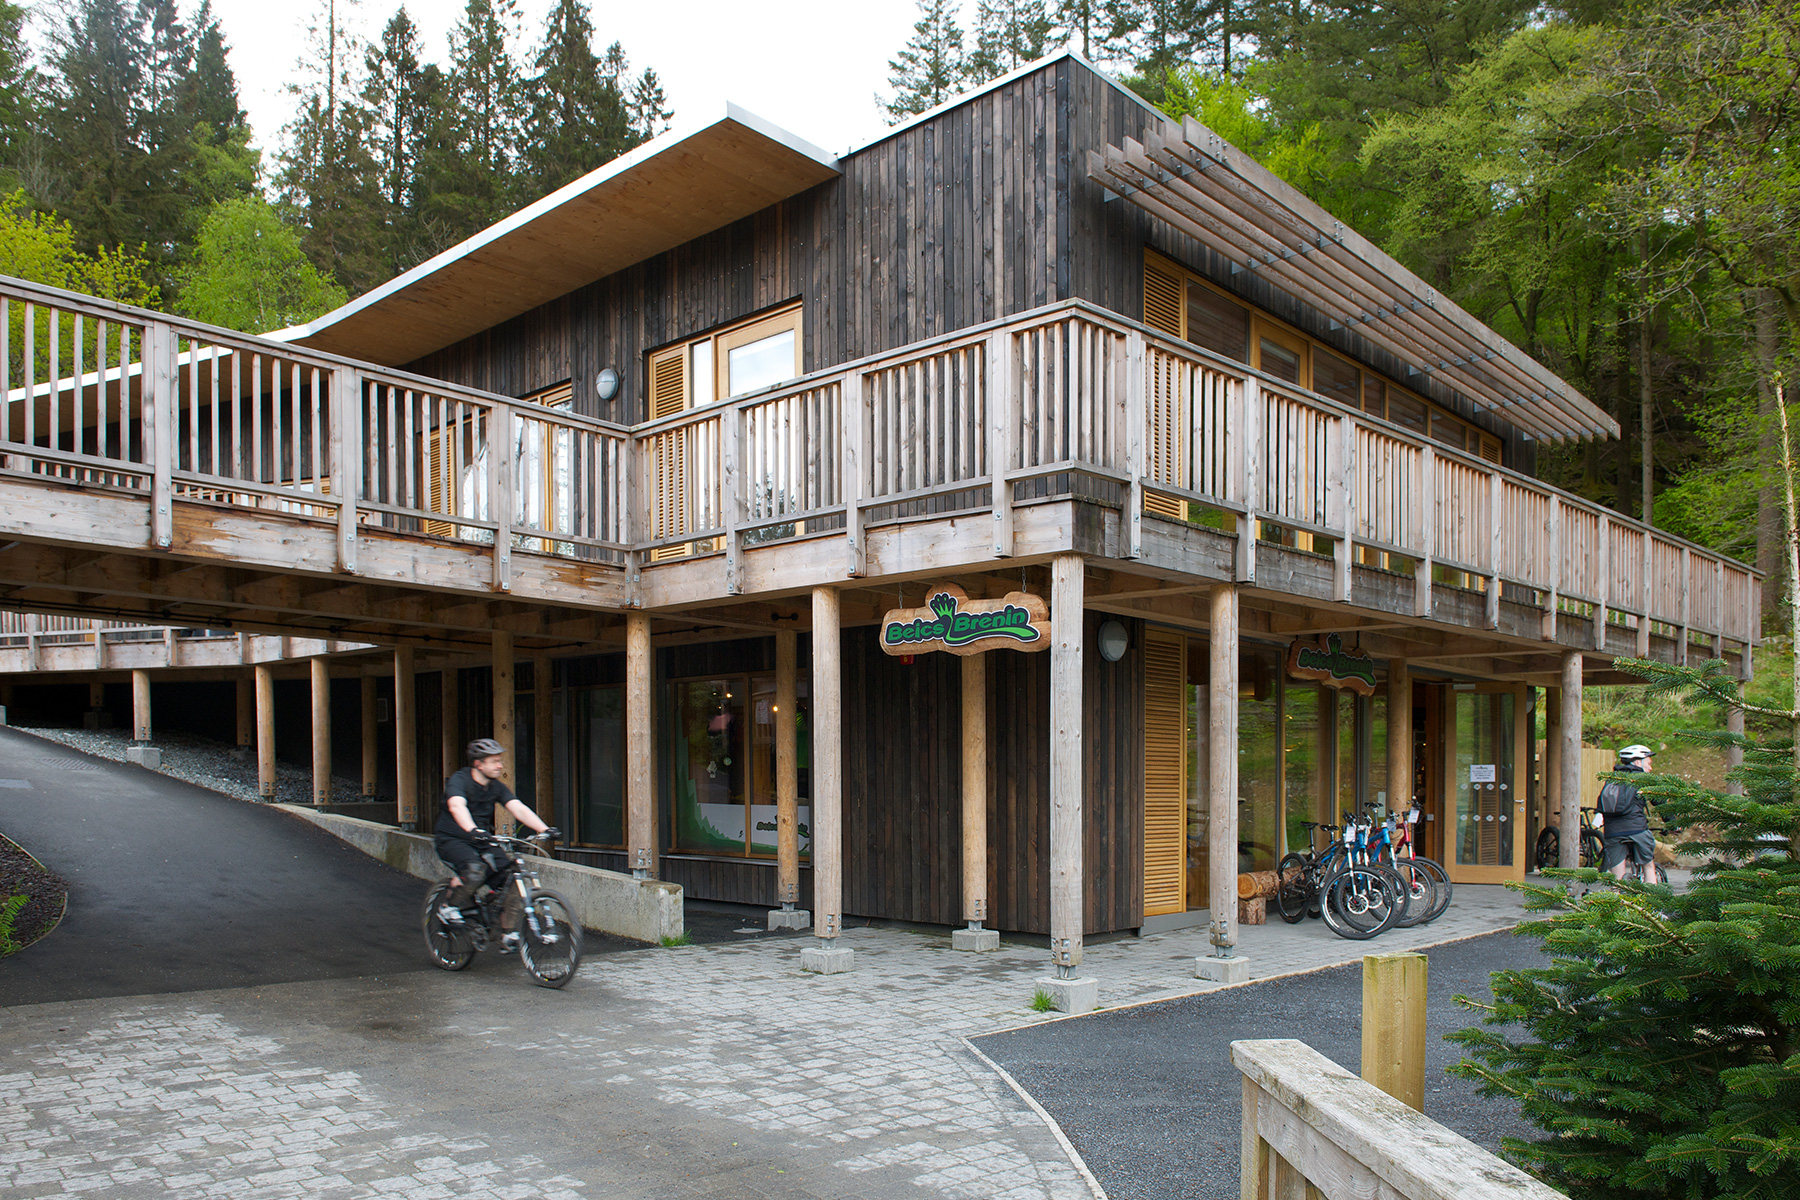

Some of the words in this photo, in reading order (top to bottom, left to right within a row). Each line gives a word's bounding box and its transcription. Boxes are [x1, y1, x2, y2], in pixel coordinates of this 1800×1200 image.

[887, 623, 944, 641] Beics
[954, 609, 1026, 632] Brenin
[1299, 650, 1333, 669] Beics
[1339, 656, 1372, 672] Brenin
